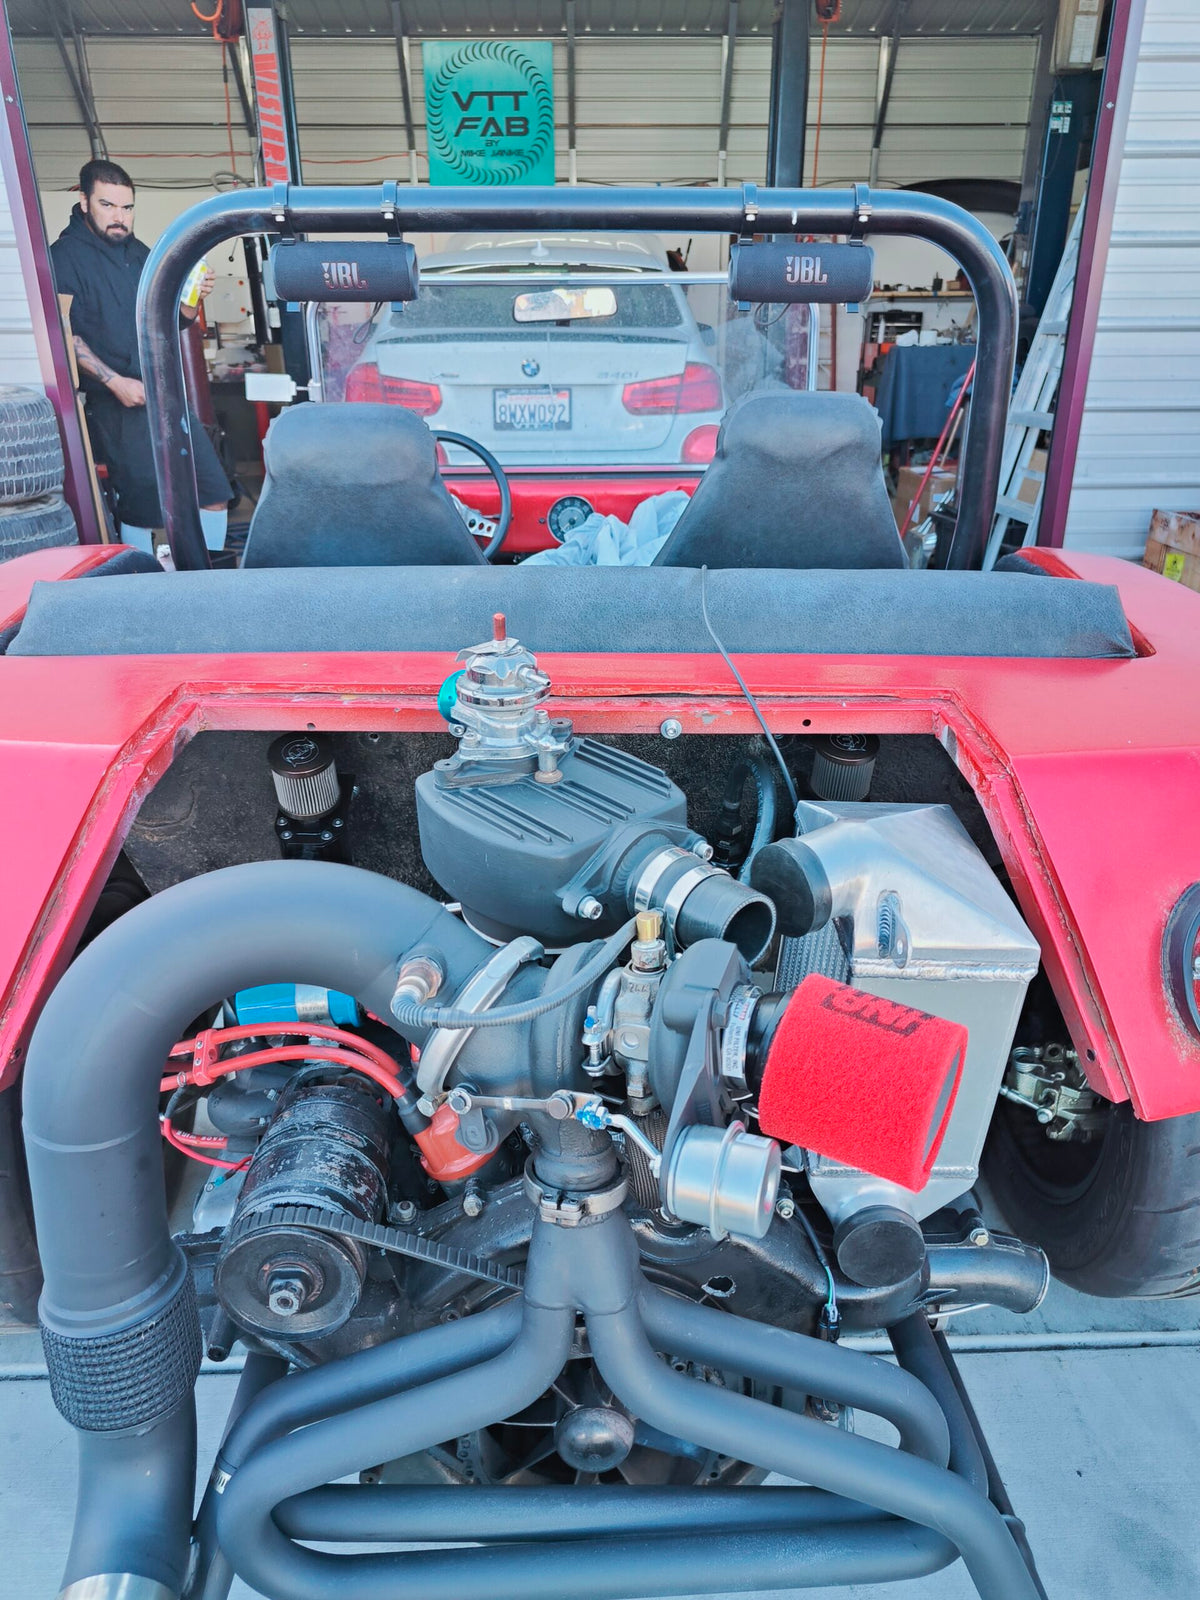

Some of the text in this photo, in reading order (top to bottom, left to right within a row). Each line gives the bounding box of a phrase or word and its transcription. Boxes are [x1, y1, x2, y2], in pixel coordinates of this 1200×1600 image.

[451, 91, 528, 112] VTT
[454, 116, 530, 138] FAB
[460, 149, 486, 157] MIKE
[485, 139, 500, 147] BY
[321, 262, 368, 290] JBL
[786, 256, 828, 284] JBL
[499, 404, 566, 424] 8WXW092
